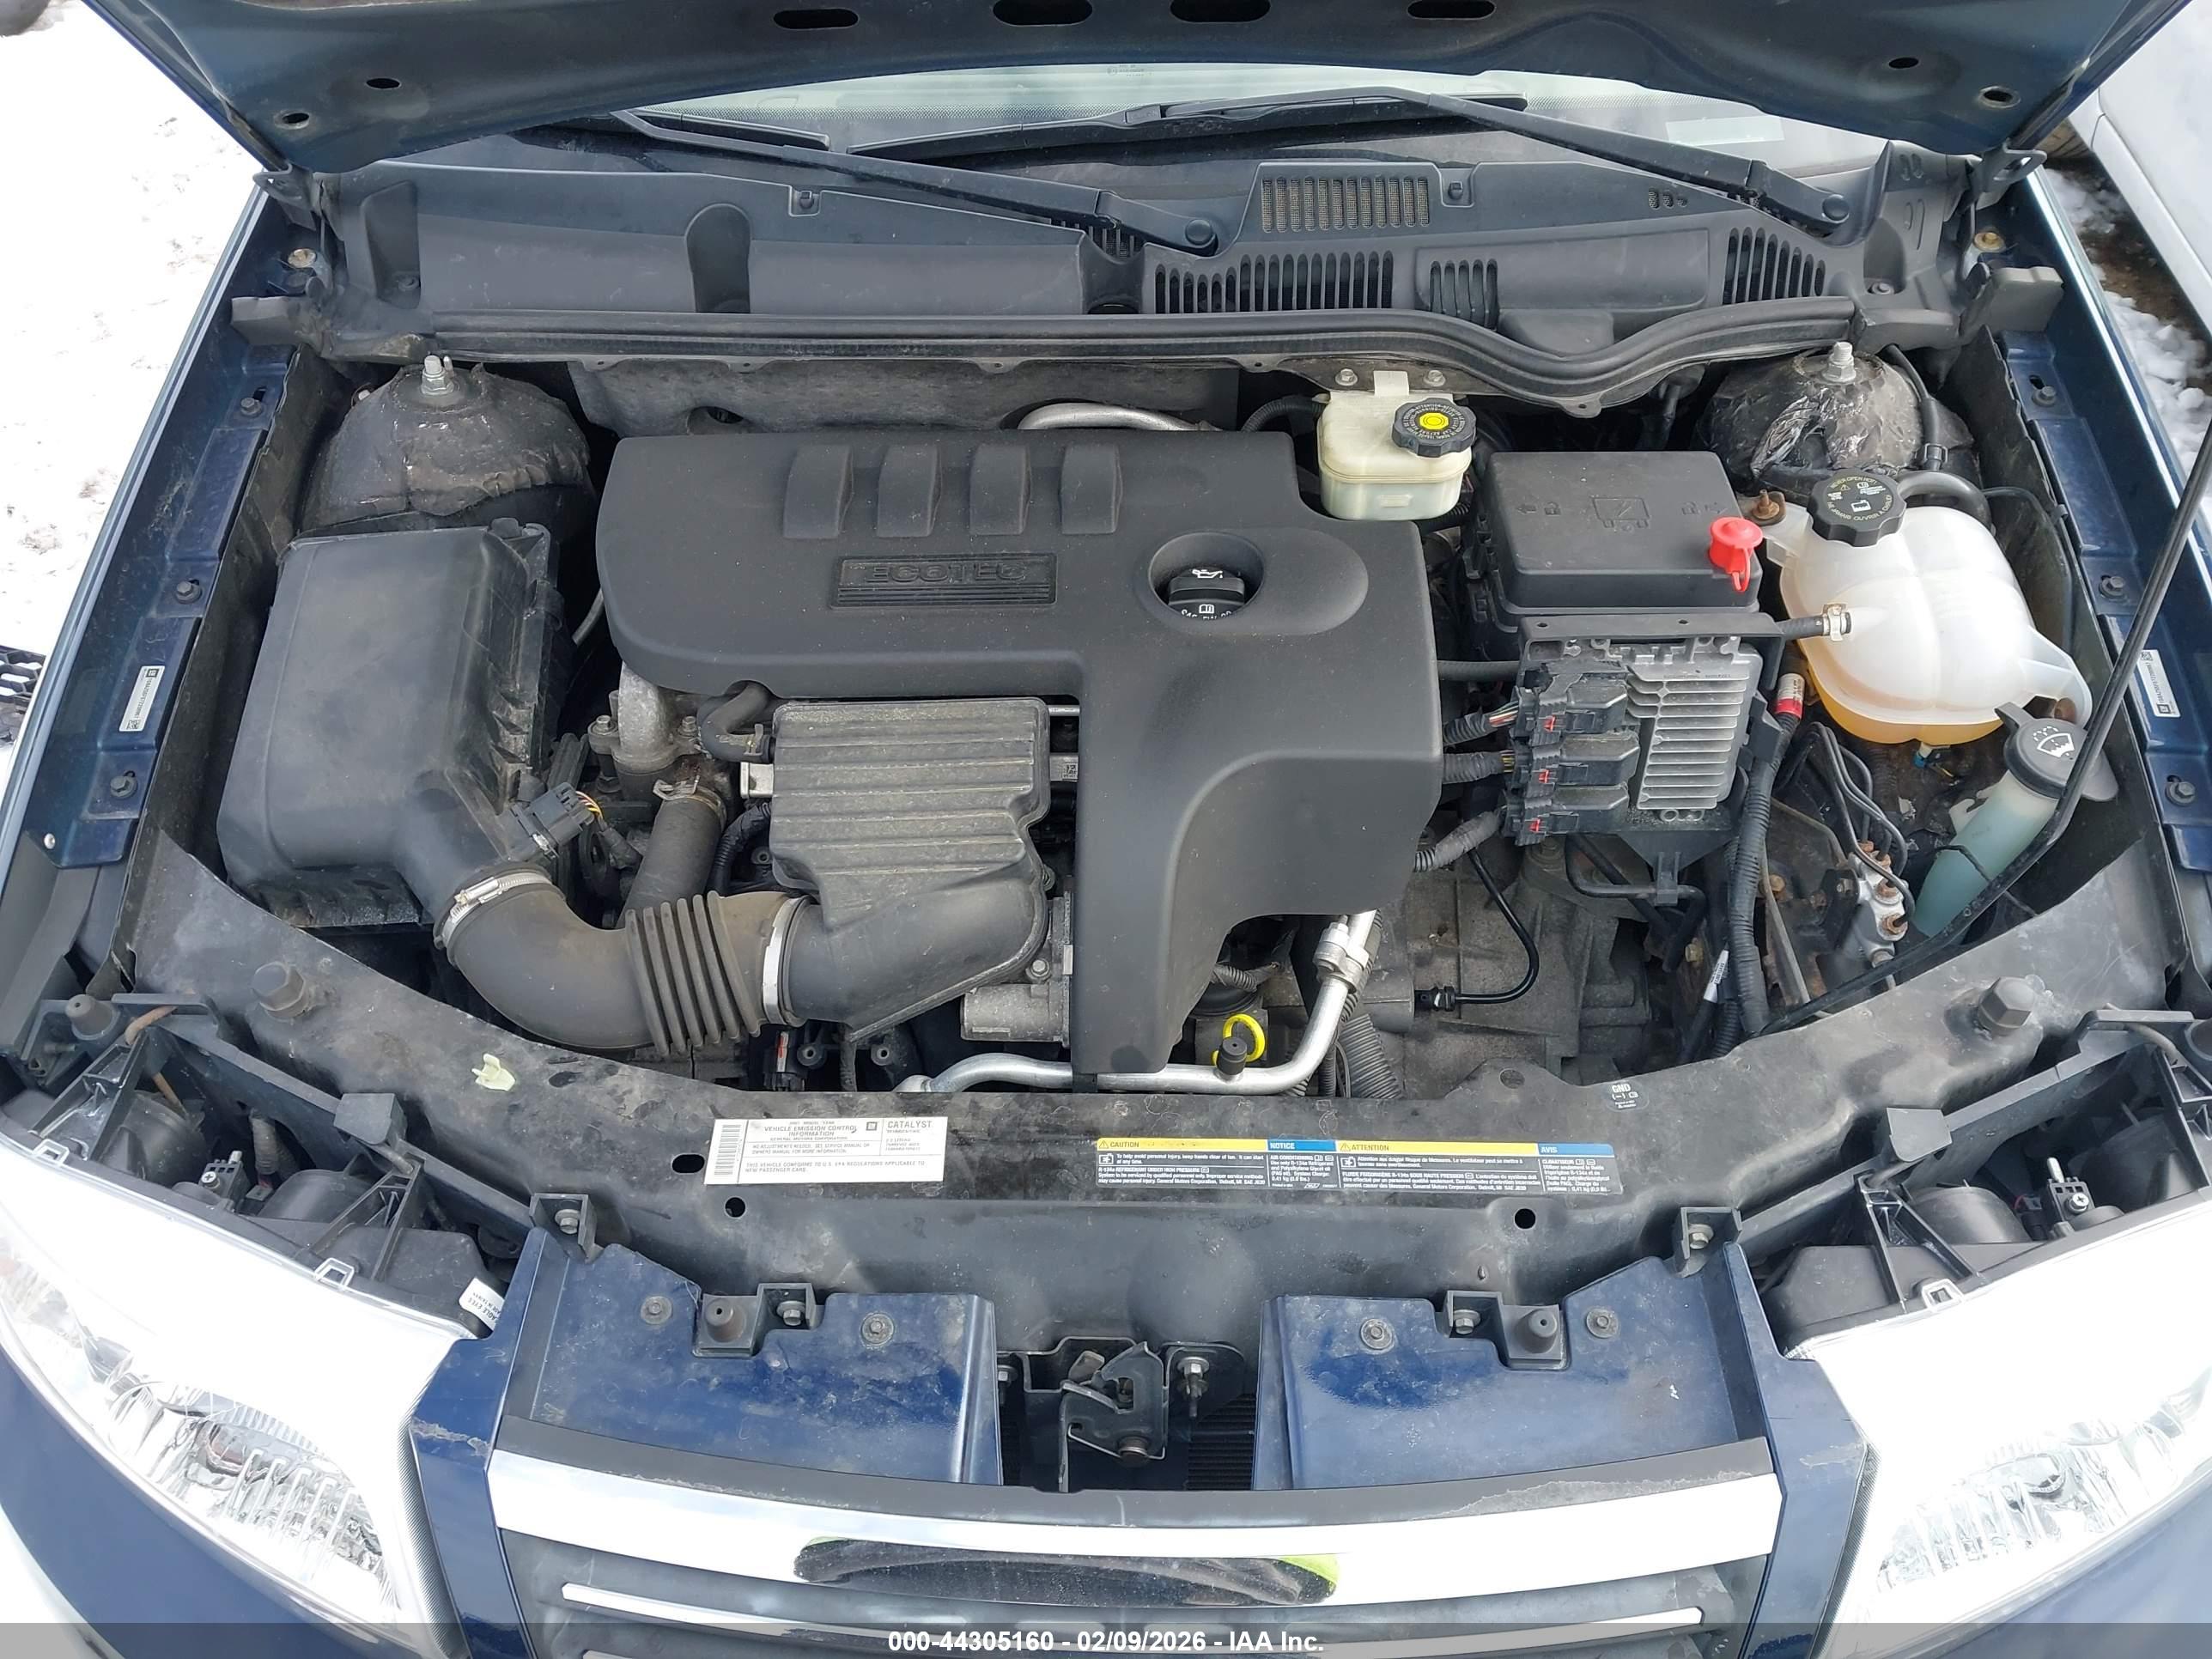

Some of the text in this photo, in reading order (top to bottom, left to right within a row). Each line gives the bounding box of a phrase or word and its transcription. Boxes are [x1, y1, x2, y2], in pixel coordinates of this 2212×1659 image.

[865, 562, 1026, 584] ECOTEC
[1611, 1083, 1632, 1093] GND
[469, 1297, 483, 1309] EYES
